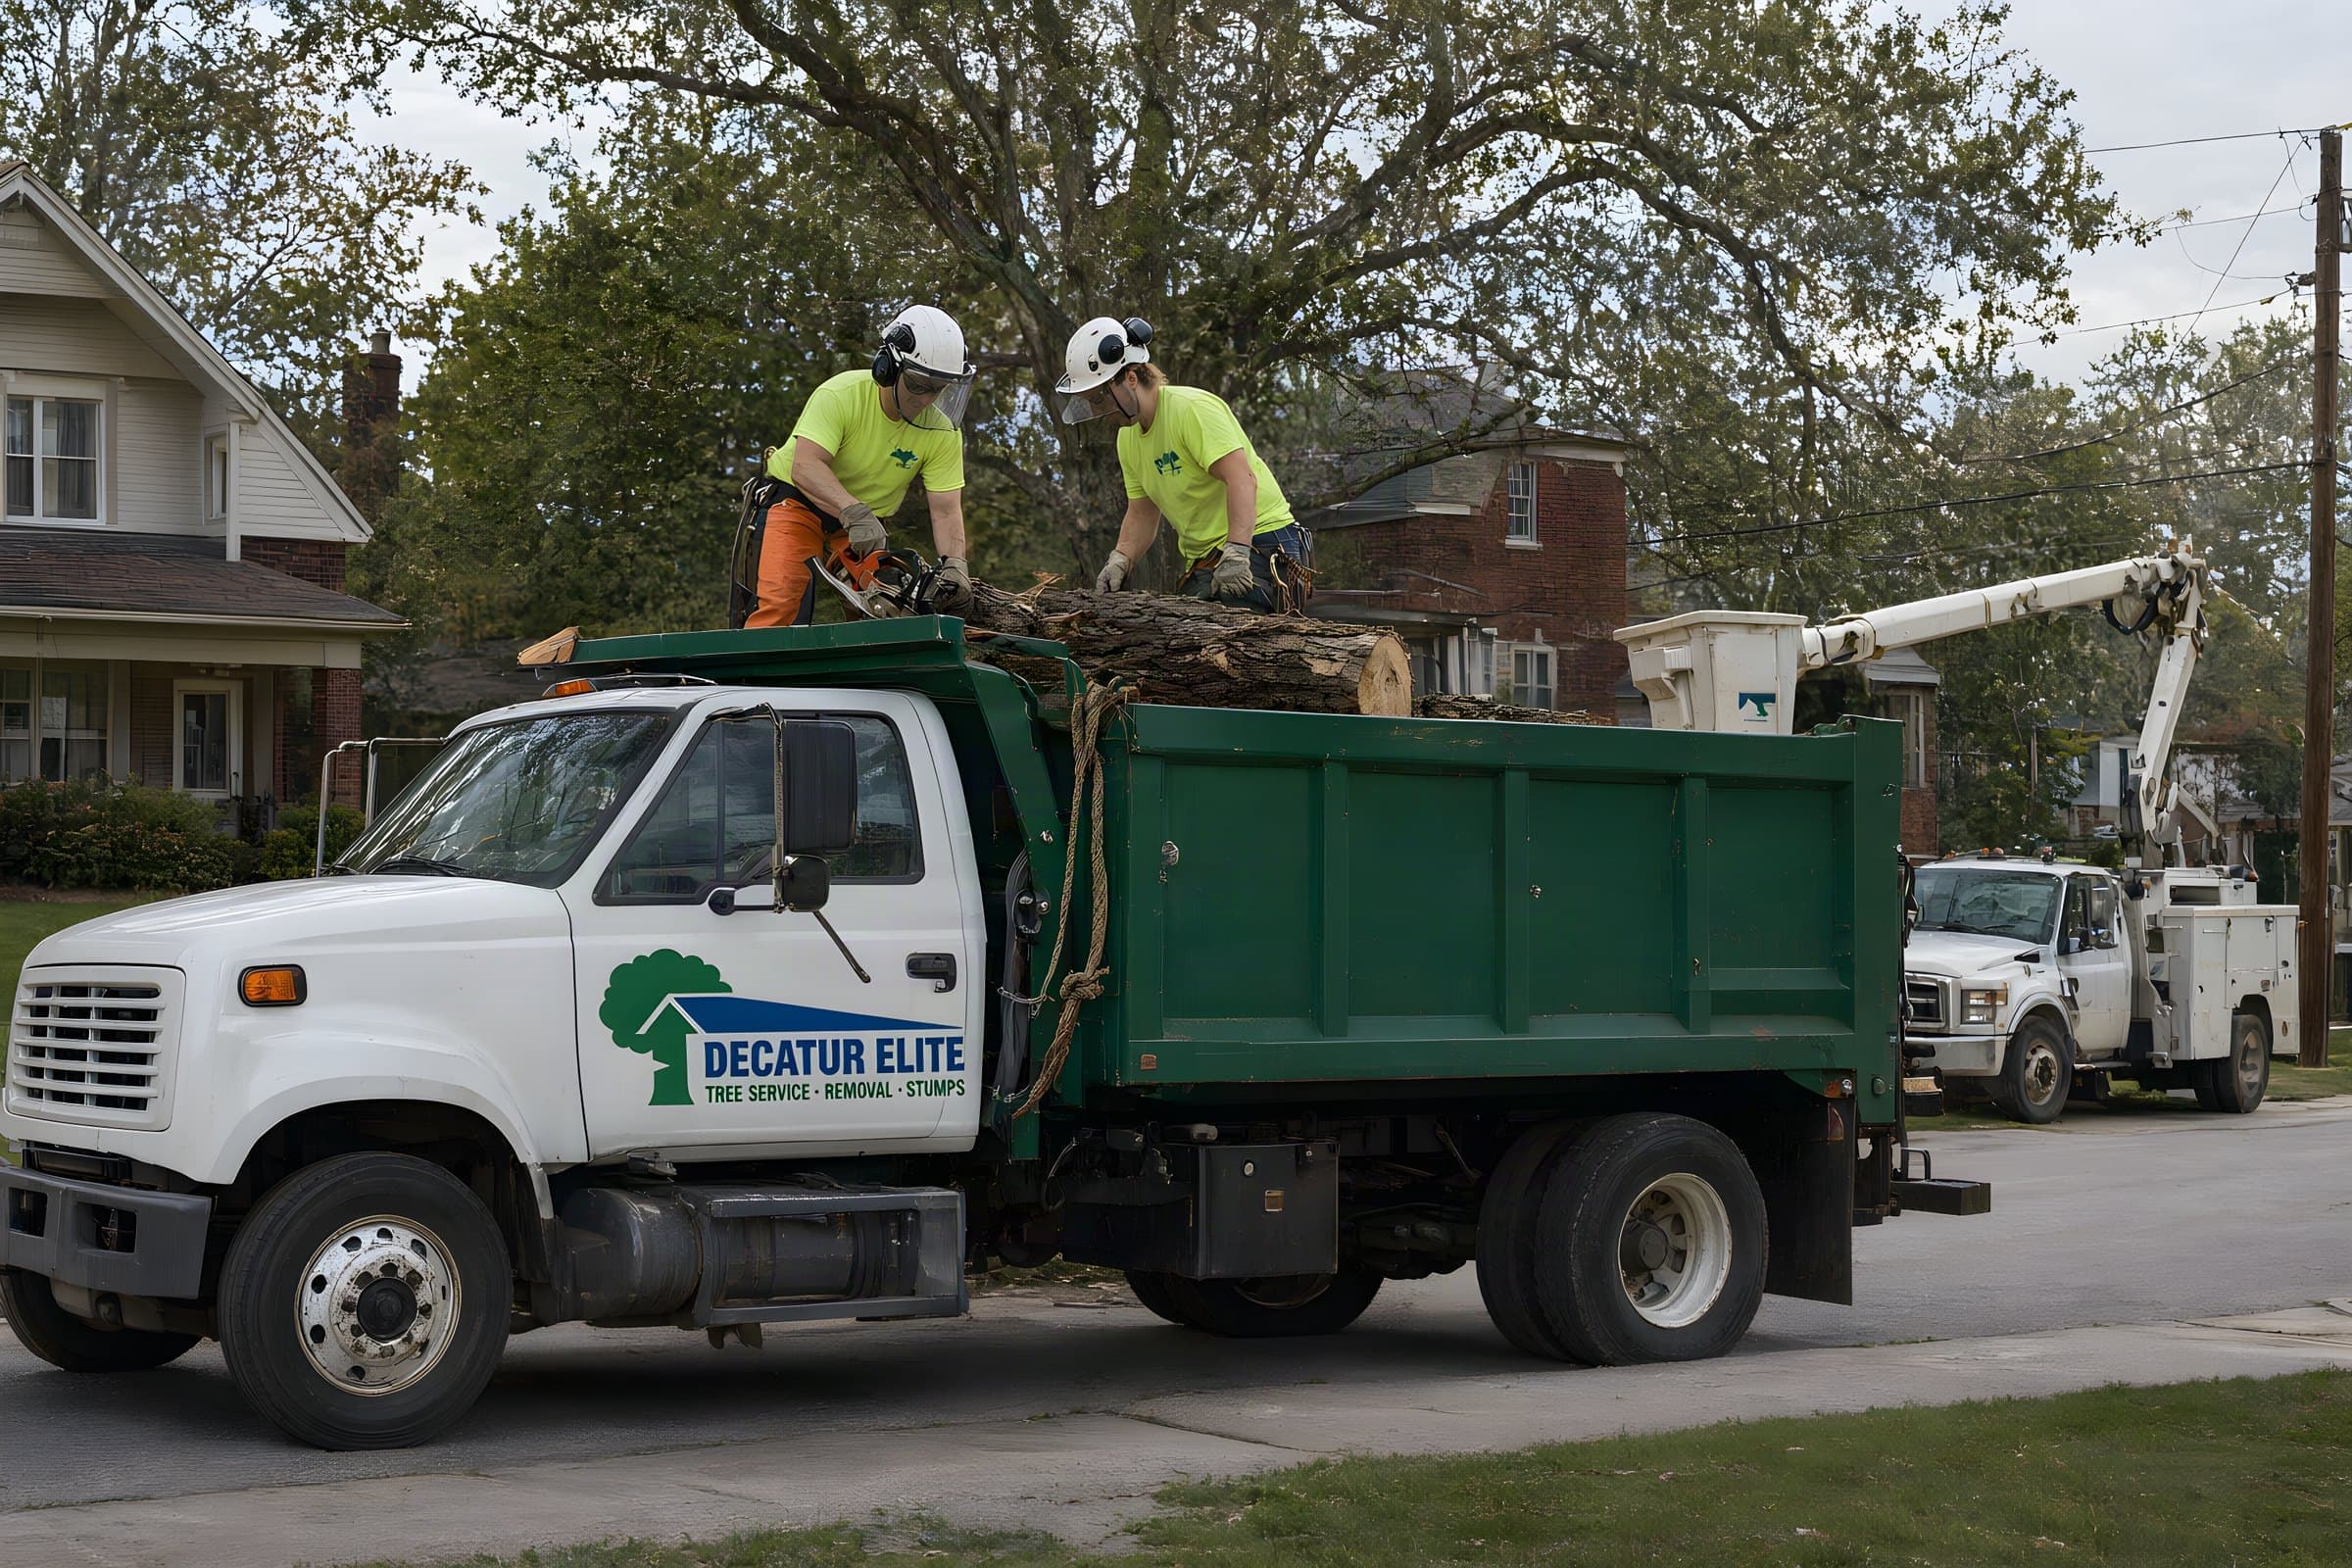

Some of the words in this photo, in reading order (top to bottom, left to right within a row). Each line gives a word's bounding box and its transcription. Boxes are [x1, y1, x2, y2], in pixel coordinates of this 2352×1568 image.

[705, 1039, 864, 1078] DECATUR
[876, 1037, 964, 1074] ELITE
[706, 1085, 743, 1102] TREE
[748, 1083, 810, 1102] SERVICE
[824, 1081, 893, 1100] REMOVAL
[906, 1079, 965, 1098] STUMPS
